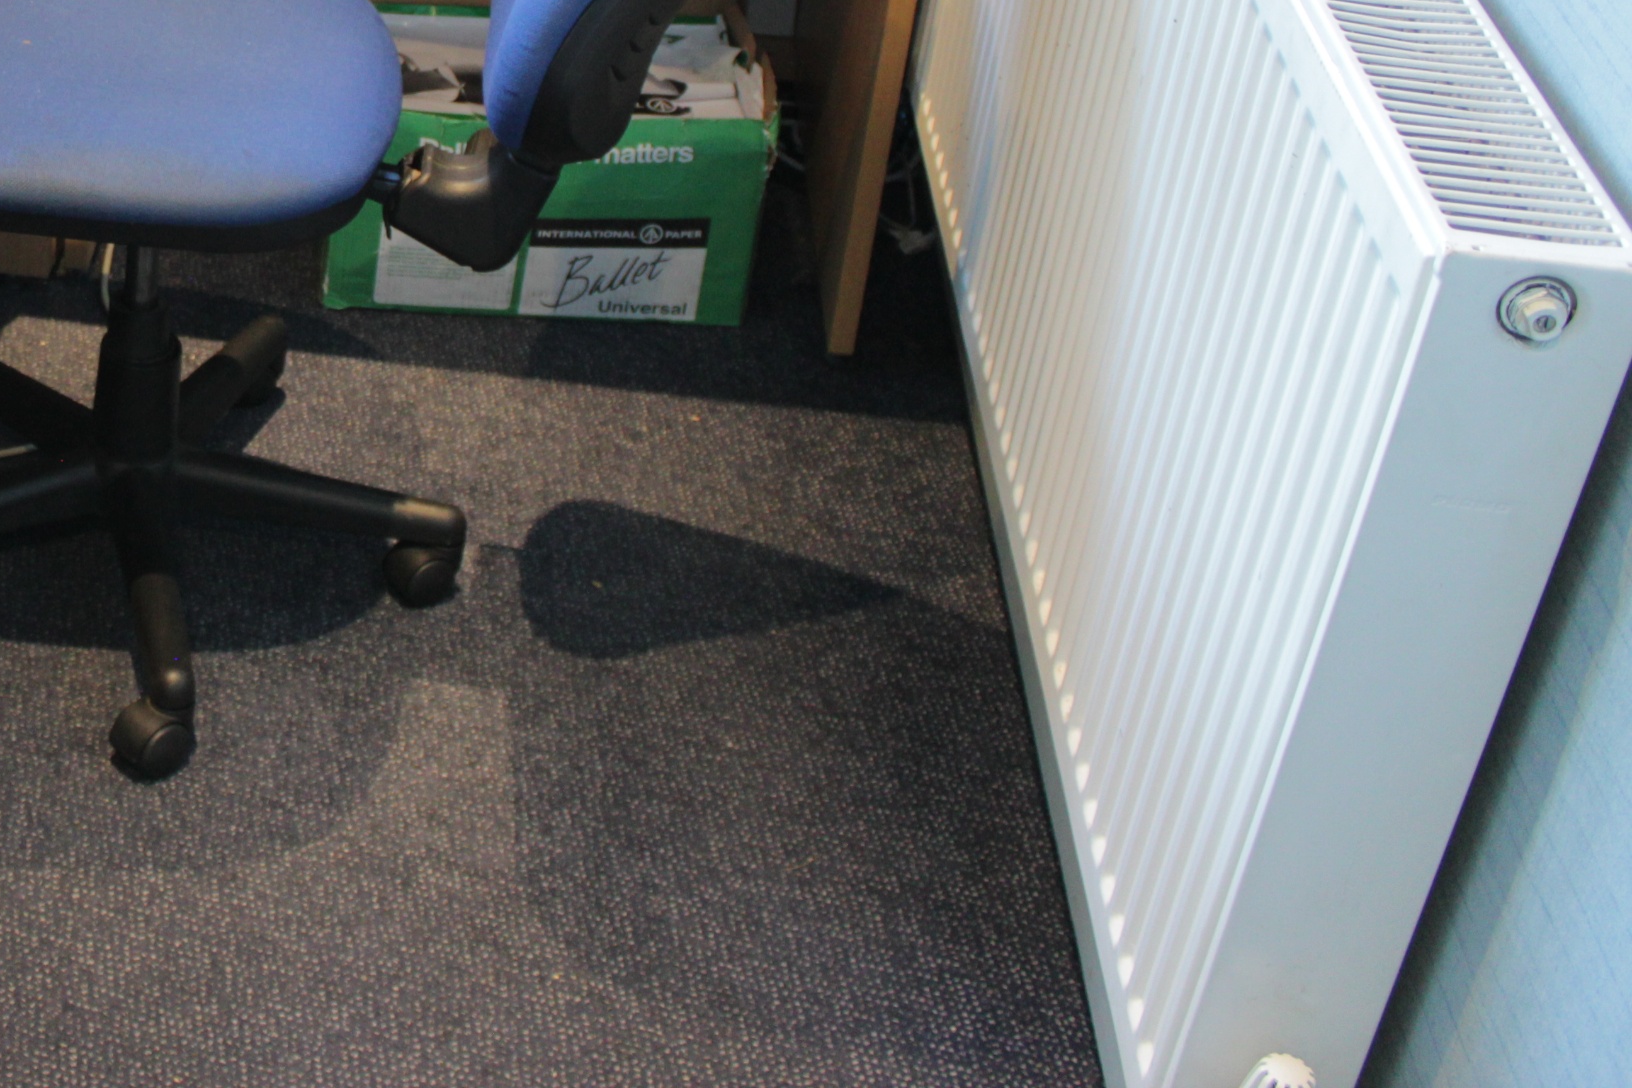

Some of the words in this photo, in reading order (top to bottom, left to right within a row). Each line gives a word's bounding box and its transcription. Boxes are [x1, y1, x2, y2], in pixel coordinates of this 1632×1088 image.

[537, 230, 636, 239] INTERNATIONAL
[665, 230, 702, 239] PAPER
[540, 251, 670, 309] Ballet
[597, 300, 688, 316] Universal
